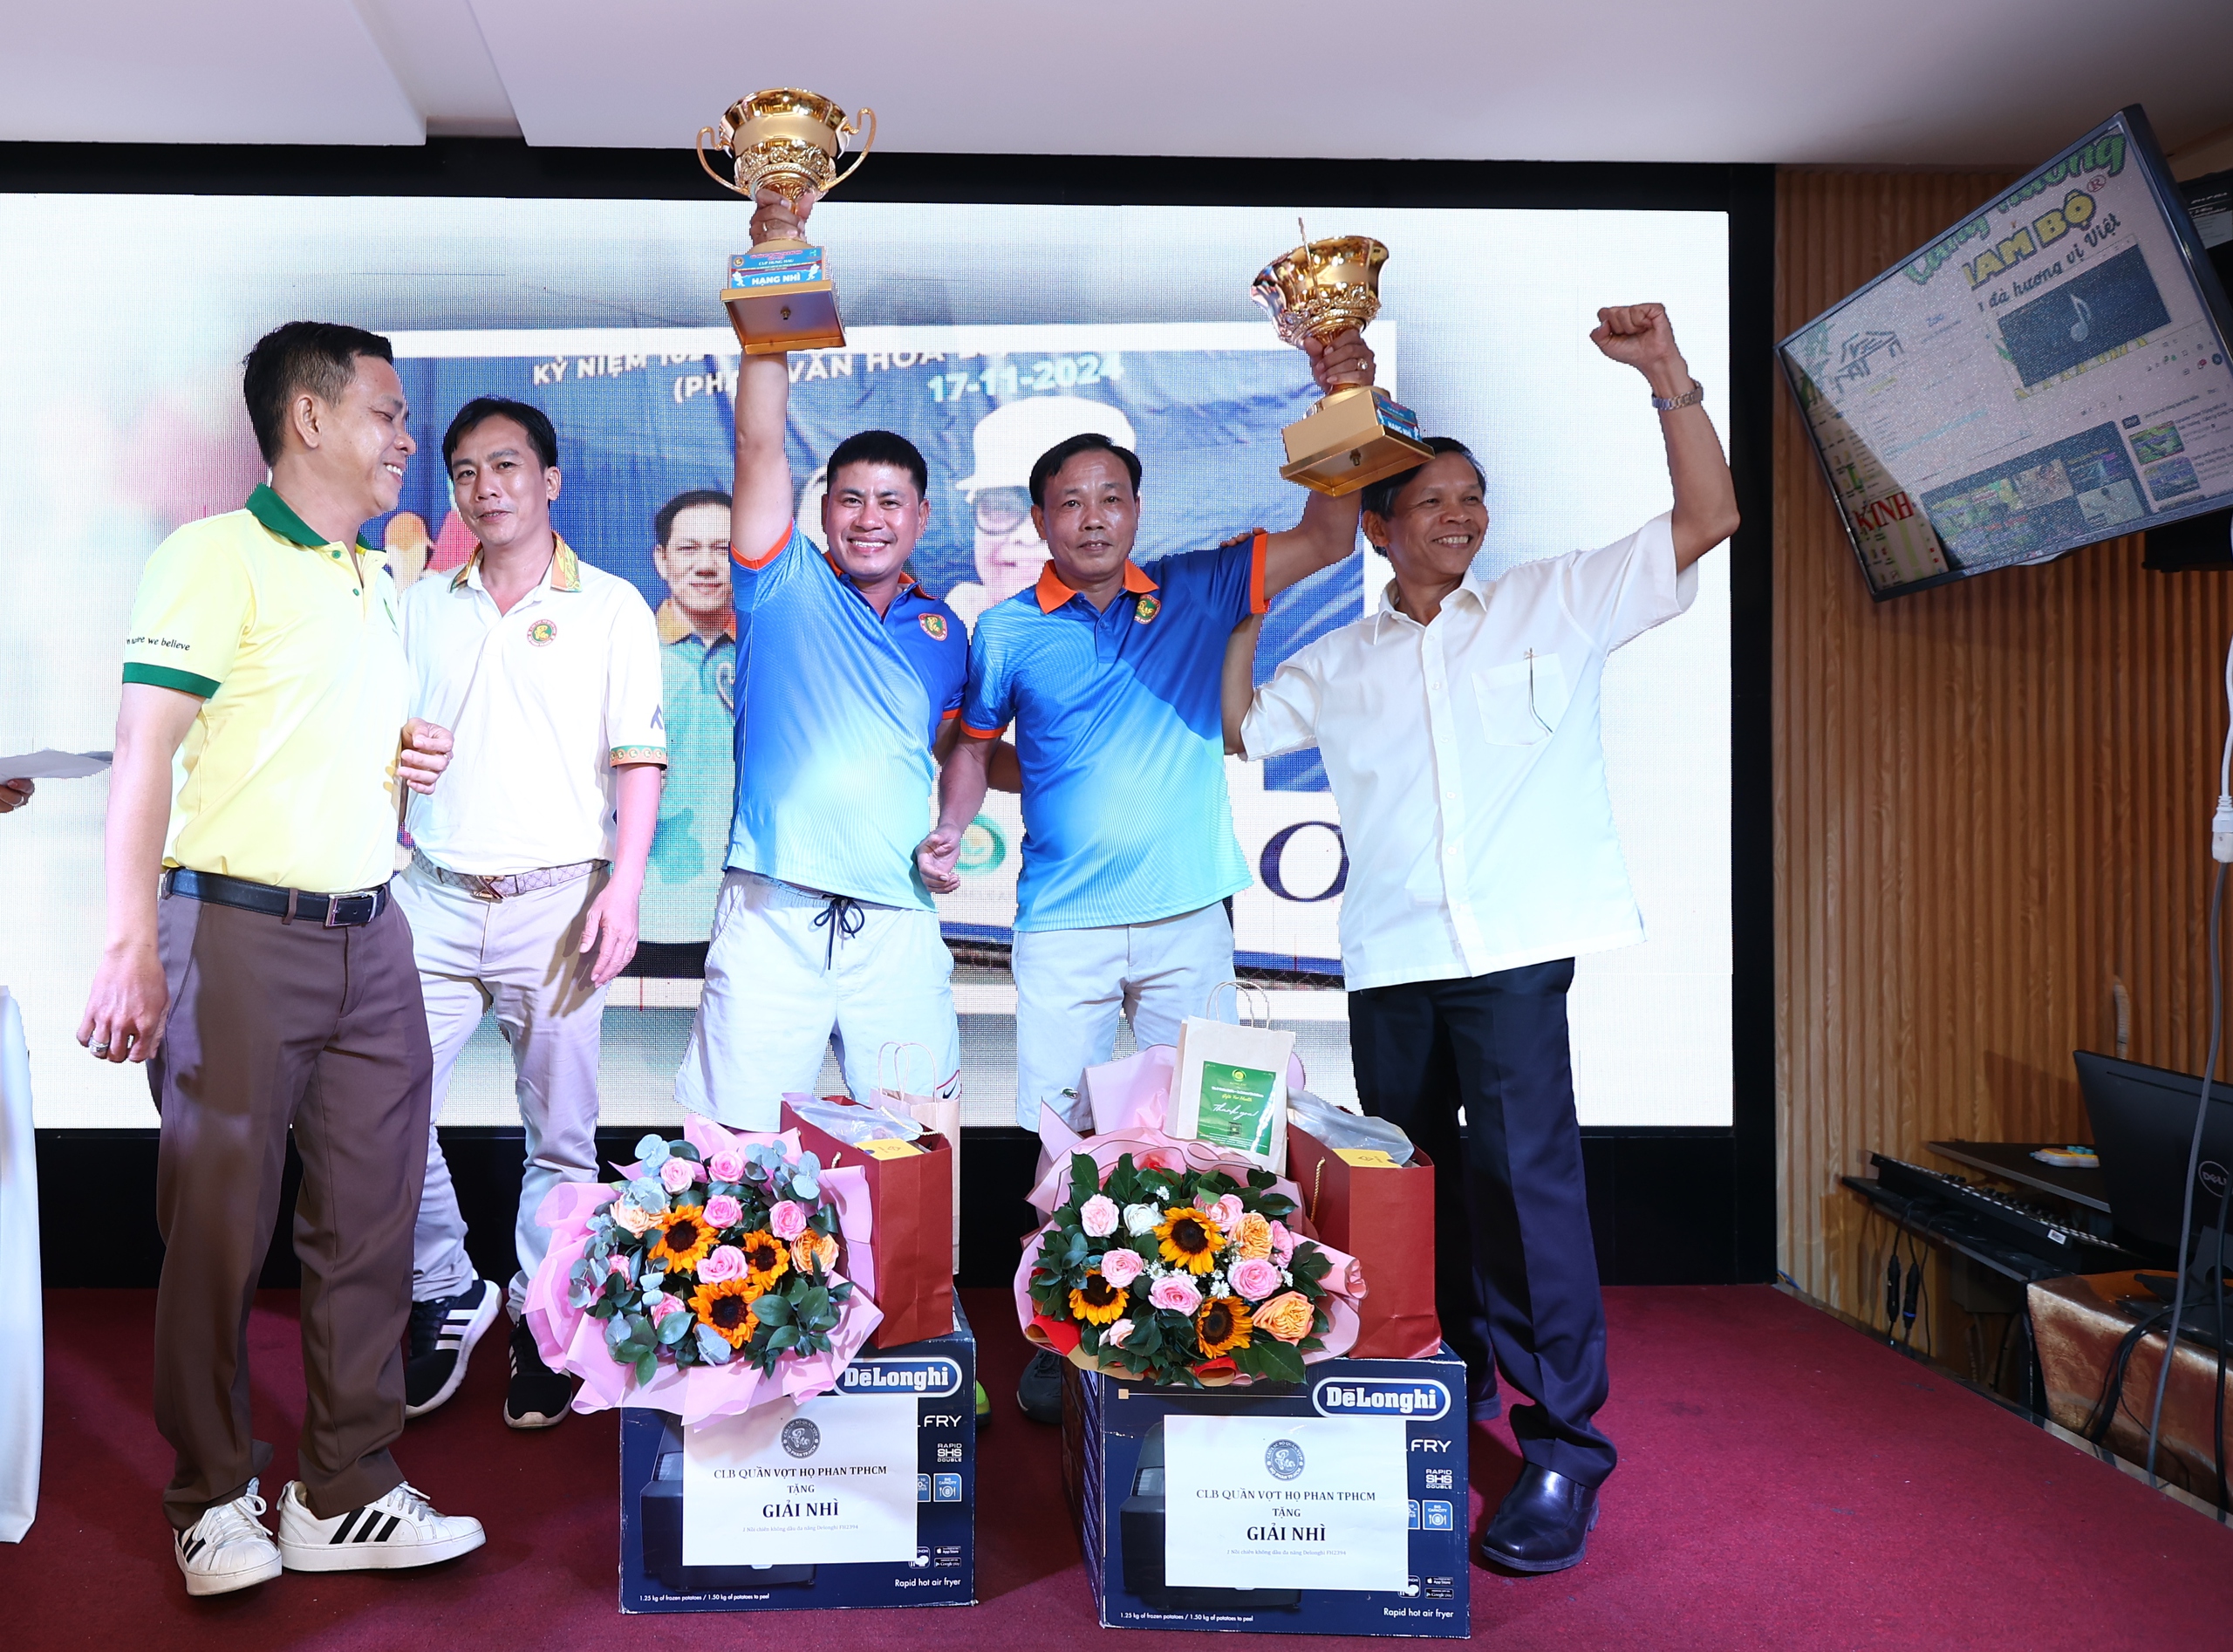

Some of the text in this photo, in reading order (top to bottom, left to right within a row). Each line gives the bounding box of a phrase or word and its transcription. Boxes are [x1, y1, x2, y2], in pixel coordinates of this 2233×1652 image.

[2032, 189, 2096, 249] BỘ
[2066, 243, 2085, 264] vị
[2085, 212, 2121, 248] Việt
[752, 271, 801, 286] HẠNG NHÌ
[927, 352, 1123, 402] 17-11-2024
[161, 638, 190, 651] believe
[1212, 1102, 1242, 1115] Thank
[924, 1415, 962, 1427] FRY
[937, 1448, 962, 1457] SHS
[1411, 1439, 1451, 1453] FRY
[714, 1466, 887, 1479] CLB QUẦN VỢT HỌ PHAN TPHCM
[1426, 1475, 1452, 1484] SHS
[787, 1483, 815, 1495] TẶNG
[1196, 1488, 1376, 1502] CLB QUẦN VỢT HỌ PHAN TPHCM
[762, 1498, 839, 1518] GIẢI NHÌ
[1272, 1506, 1301, 1519] TẶNG
[1247, 1523, 1326, 1541] GIẢI NHÌ
[895, 1578, 916, 1589] Rapid
[918, 1578, 930, 1586] hot
[944, 1577, 961, 1588] fryer
[1384, 1608, 1454, 1620] Rapid hot air fryer
